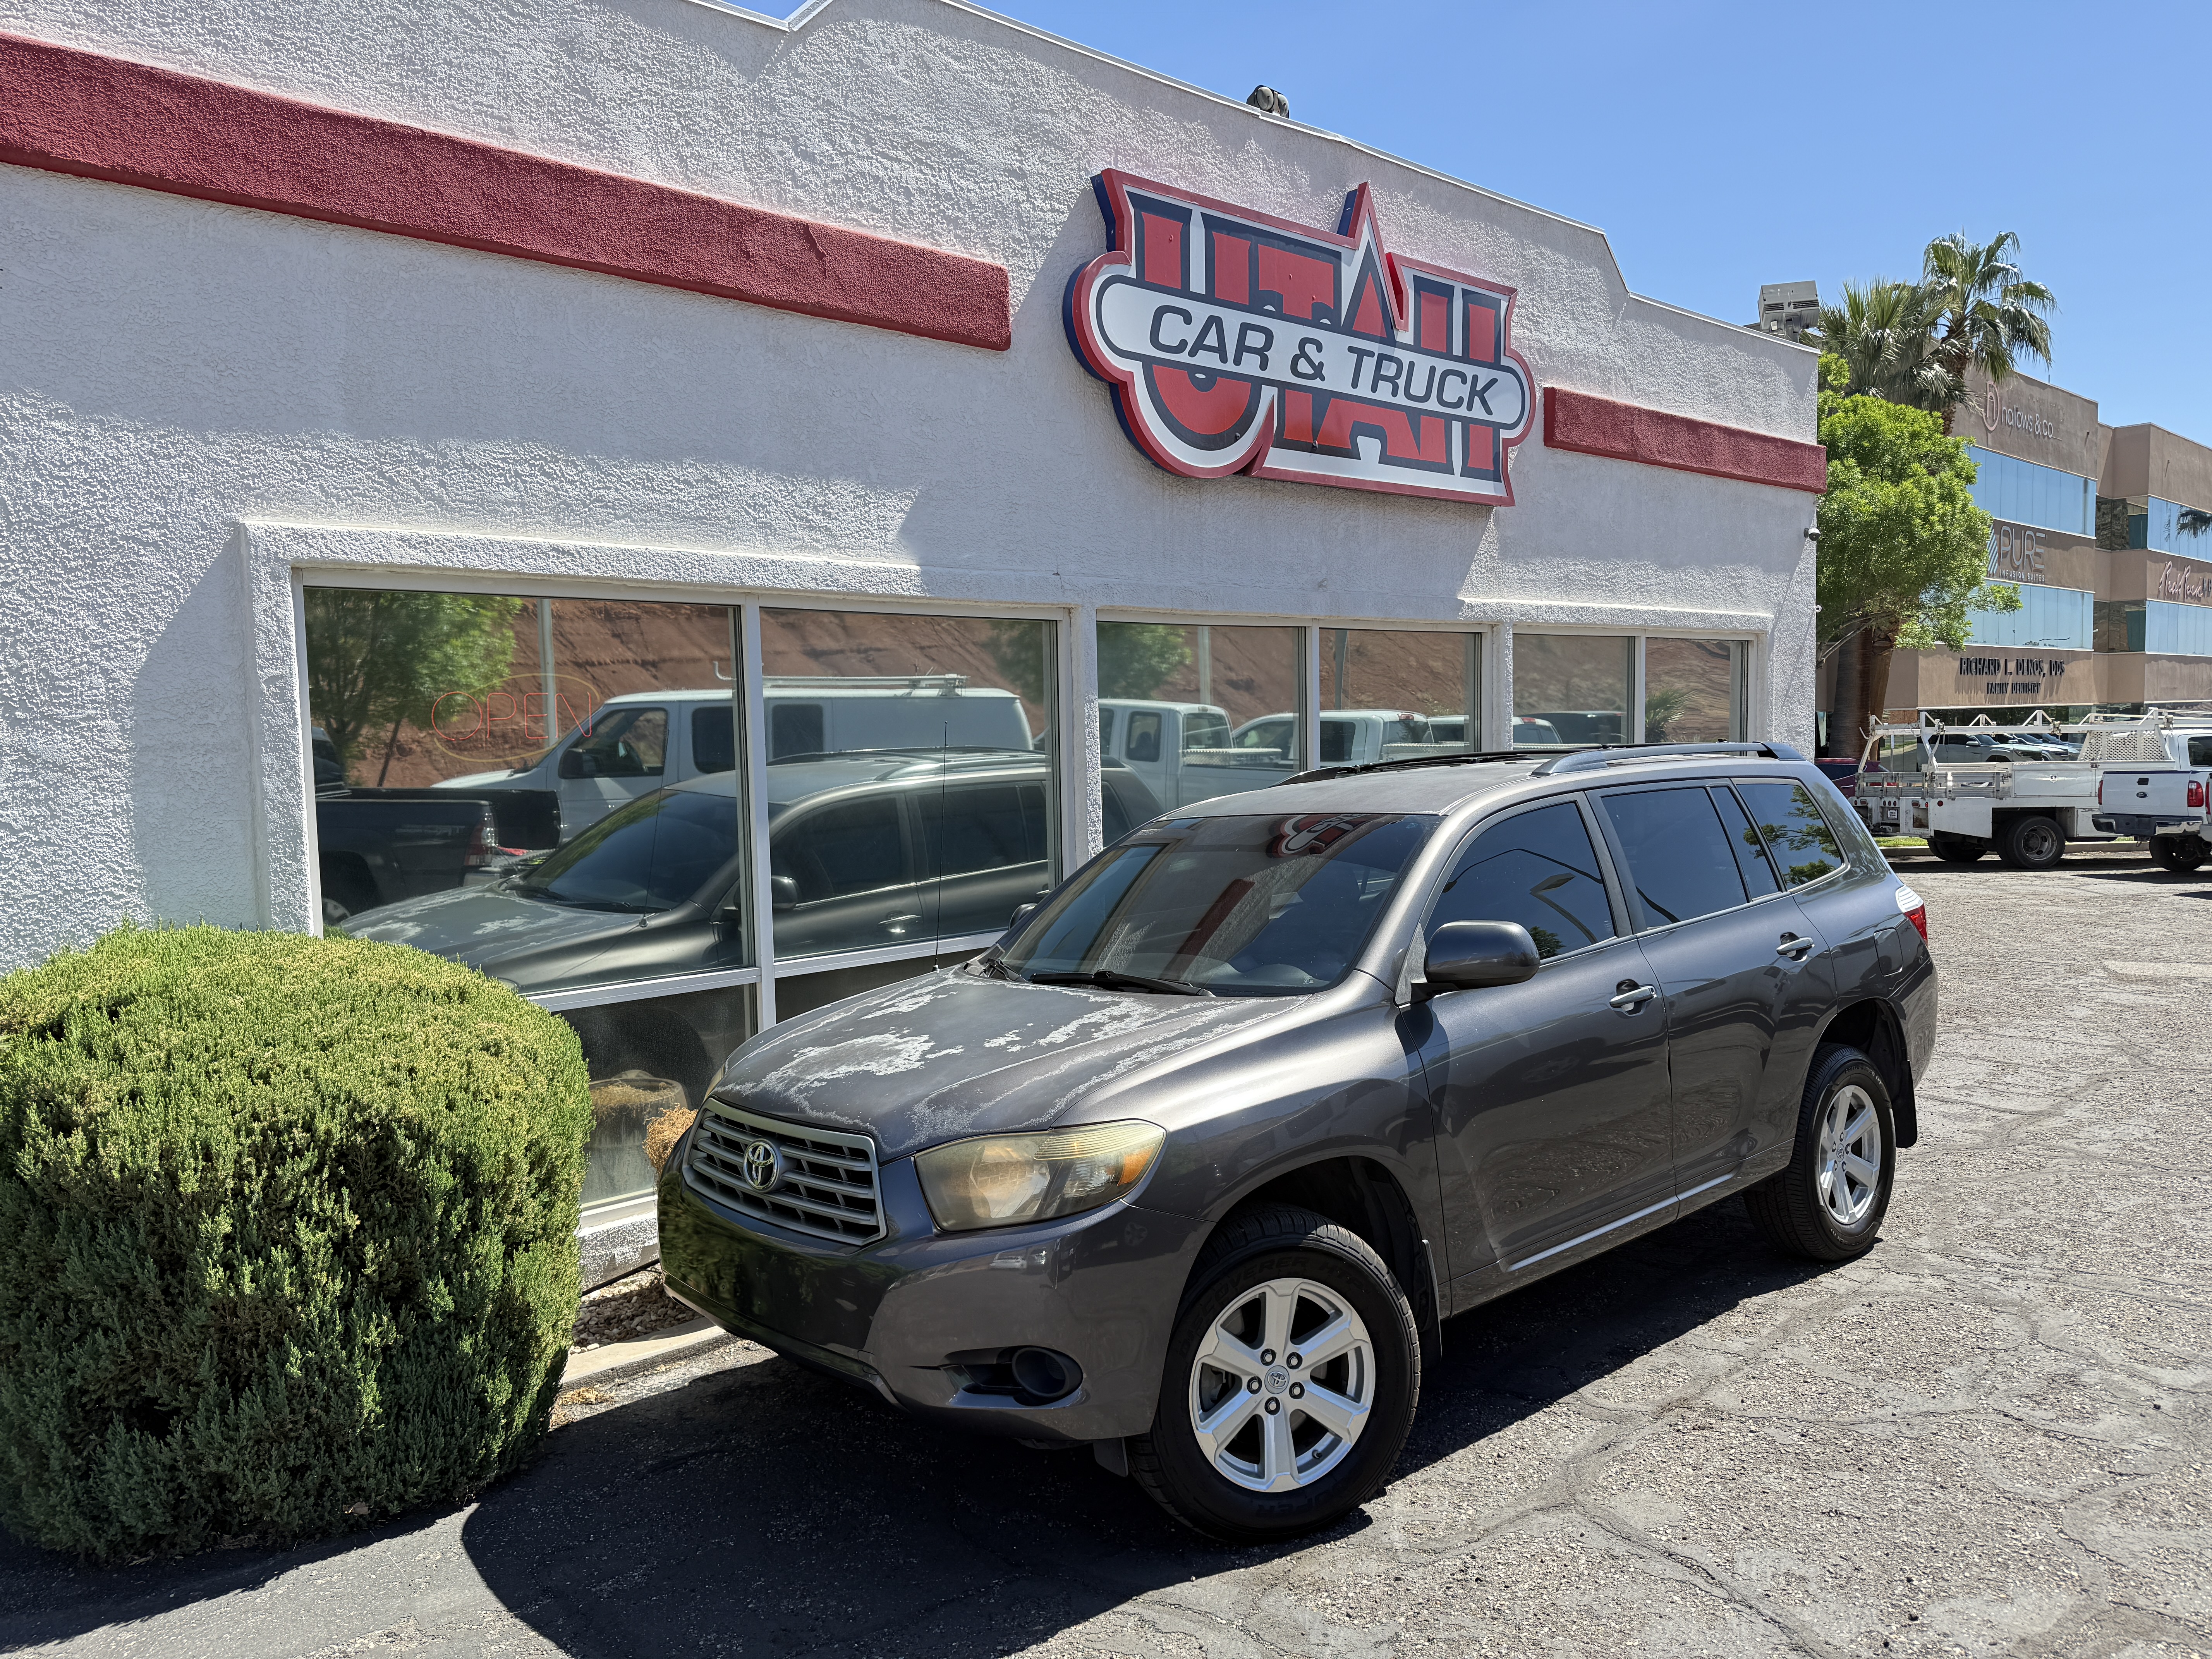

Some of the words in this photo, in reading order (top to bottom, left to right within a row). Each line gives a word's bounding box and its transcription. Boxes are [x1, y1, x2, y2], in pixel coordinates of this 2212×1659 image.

[1125, 191, 1502, 483] UTAH
[1150, 304, 1274, 371] CAR
[1290, 337, 1326, 381] &
[1347, 345, 1499, 416] TRUCK
[2002, 401, 2033, 431] hallows
[2035, 414, 2041, 434] &
[2043, 420, 2053, 438] co
[2001, 526, 2045, 568] PURE
[2000, 569, 2025, 579] INFUSION
[2027, 573, 2045, 581] SUITES
[1960, 657, 2001, 675] RICHARD
[2005, 658, 2013, 675] L.
[2050, 659, 2065, 676] DDS
[1987, 682, 2009, 694] FAMILY
[2011, 682, 2042, 694] DENTISTRY
[431, 691, 592, 741] OPEN
